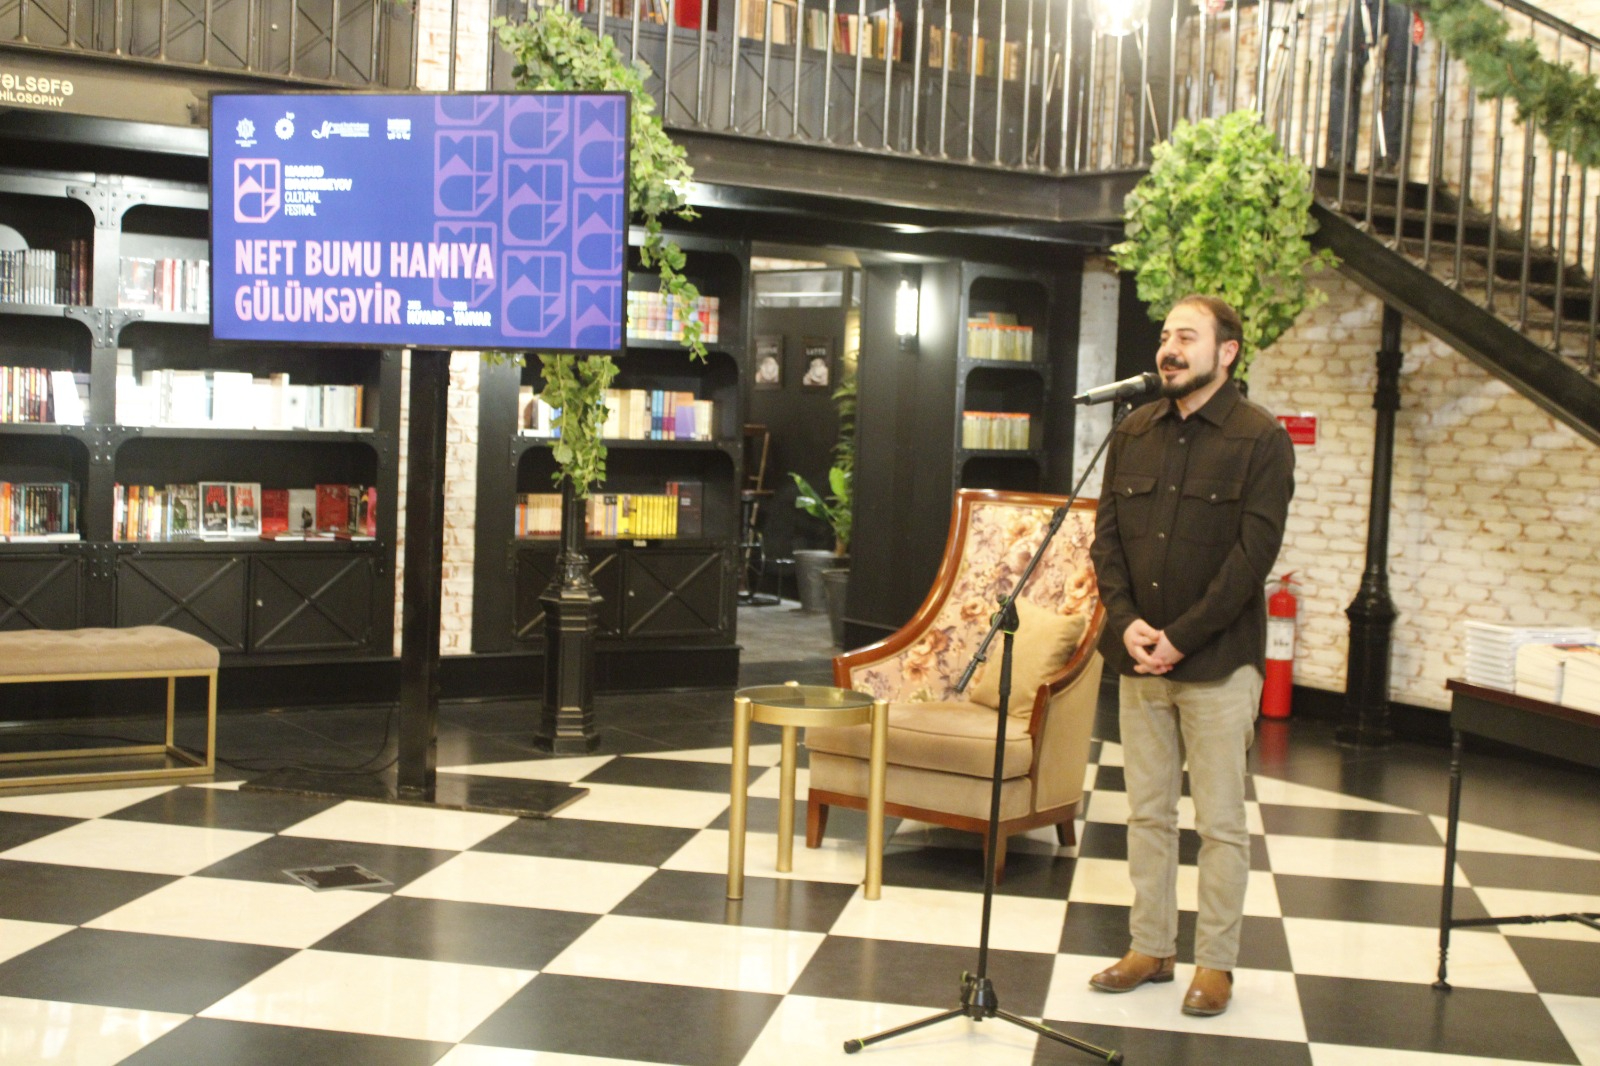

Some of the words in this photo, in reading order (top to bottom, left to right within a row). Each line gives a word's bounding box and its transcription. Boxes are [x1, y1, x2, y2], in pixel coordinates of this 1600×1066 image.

[0, 73, 74, 96] ƏLSƏFƏ
[285, 191, 321, 203] CULTURAL
[285, 204, 316, 216] FESTIVAL
[235, 239, 297, 276] NEFT
[305, 241, 382, 278] BUMU
[390, 242, 495, 280] HAMIYA
